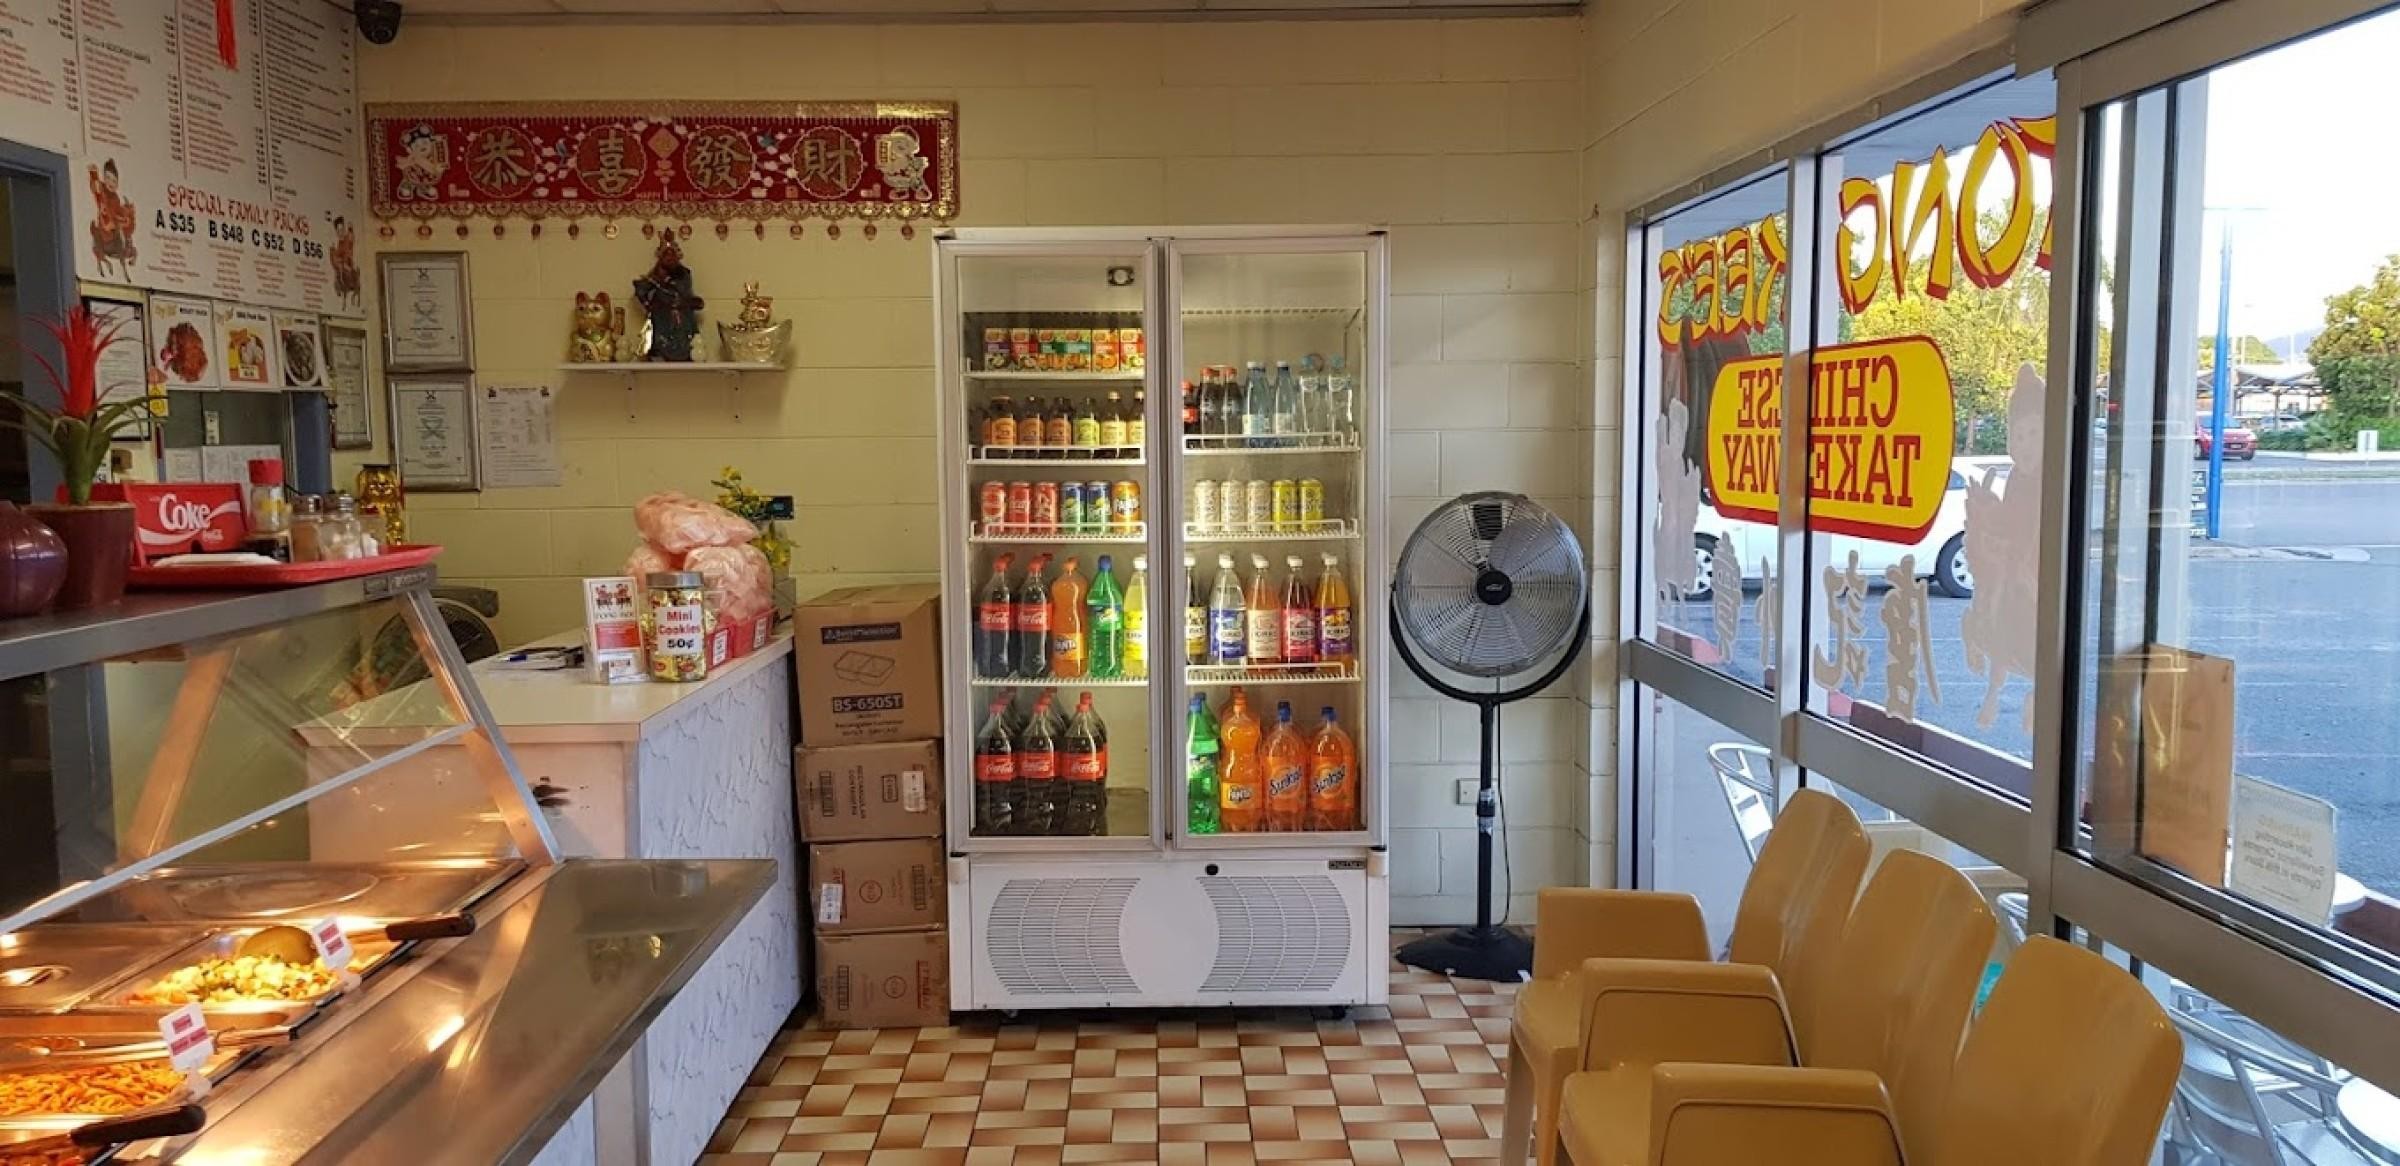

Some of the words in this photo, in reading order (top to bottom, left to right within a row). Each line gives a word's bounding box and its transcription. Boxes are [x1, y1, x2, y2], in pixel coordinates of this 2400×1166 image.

[473, 129, 857, 193] 恭喜發財
[167, 183, 225, 217] SPECIAL
[228, 199, 269, 226] FAMILY
[273, 209, 310, 236] PACKS
[156, 210, 165, 229] A
[169, 212, 195, 234] $35
[209, 220, 218, 239] B
[221, 223, 244, 244] $48
[251, 229, 260, 247] C
[263, 231, 285, 252] $52
[292, 237, 301, 255] D
[303, 240, 324, 260] $56
[159, 493, 211, 531] Coke
[666, 611, 693, 622] Mini
[667, 638, 694, 650] 50¢
[834, 695, 901, 712] BS-650ST
